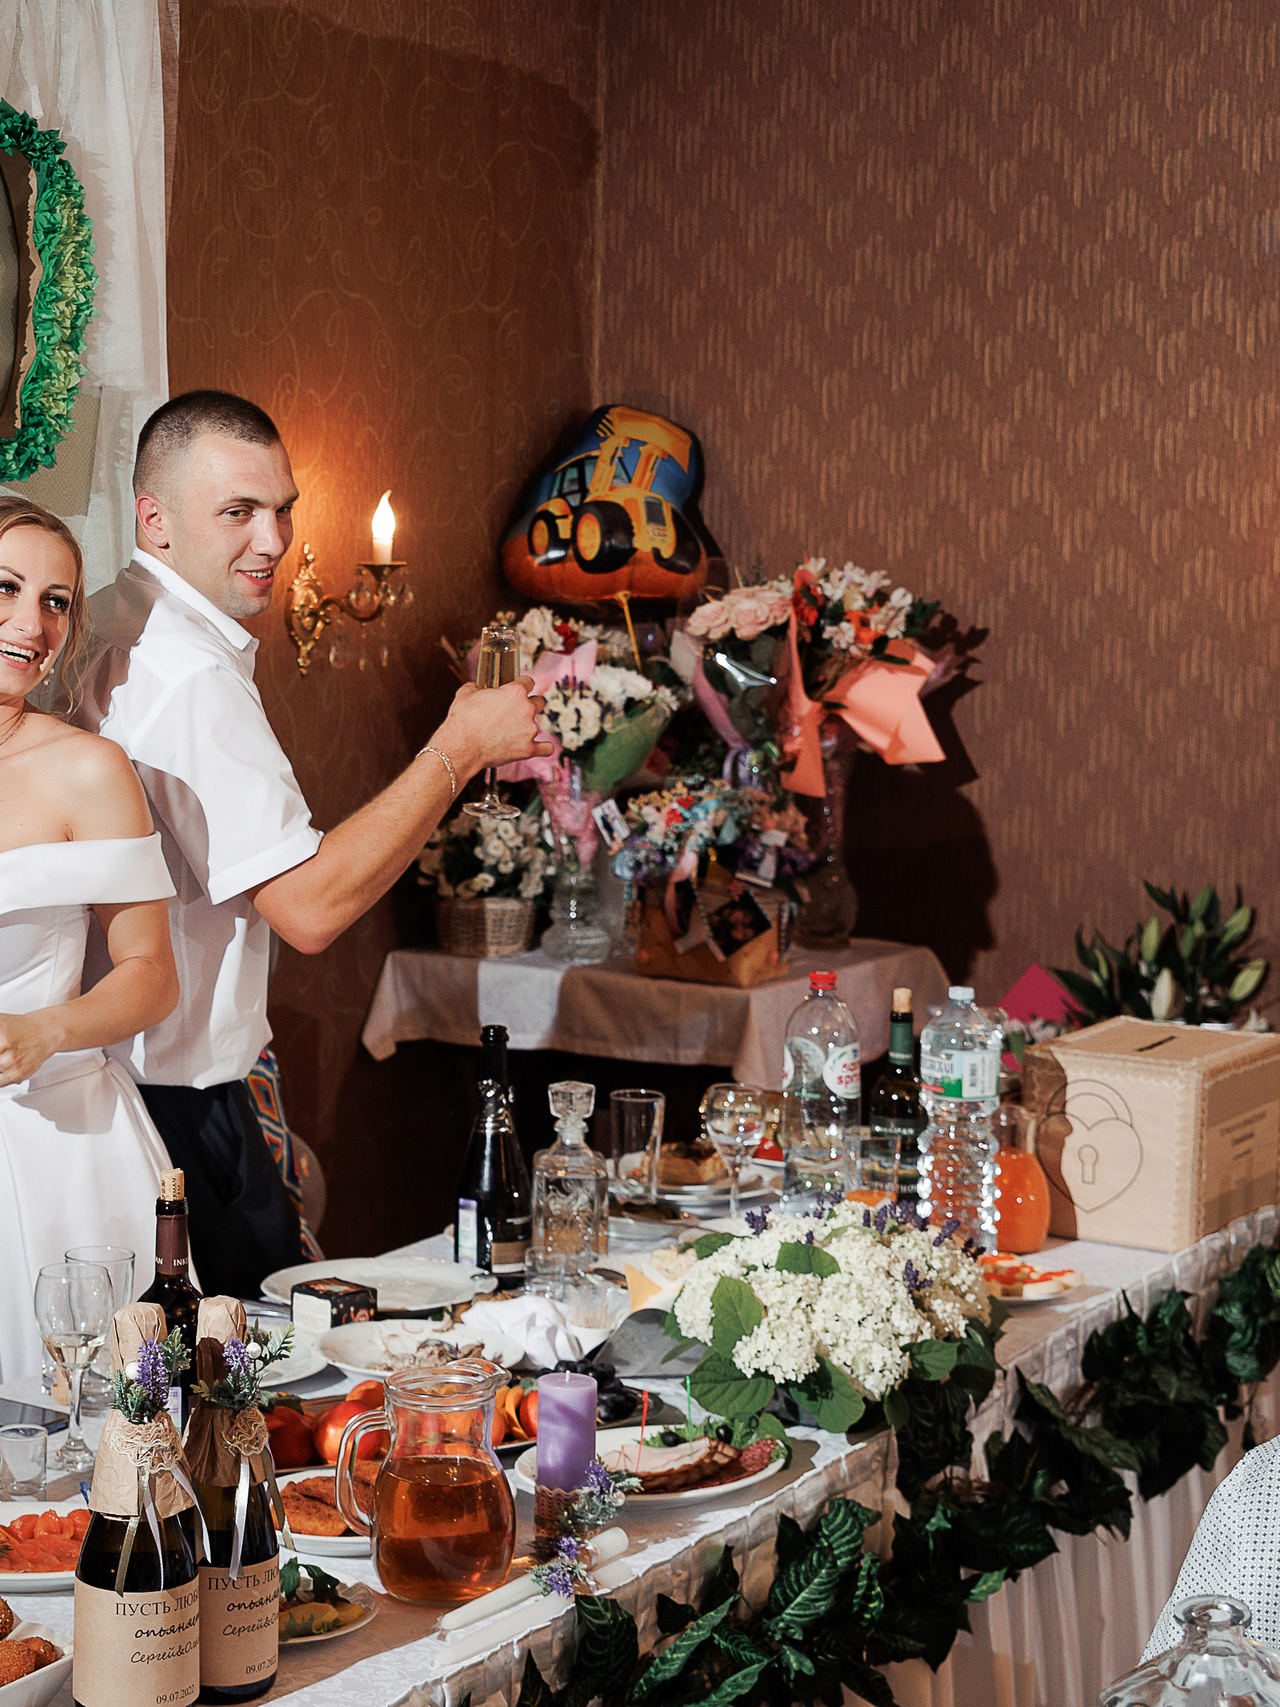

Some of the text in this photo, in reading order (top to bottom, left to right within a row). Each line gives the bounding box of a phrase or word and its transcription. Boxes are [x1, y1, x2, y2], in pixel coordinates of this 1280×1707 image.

[208, 1574, 260, 1591] ПУСТЬ
[115, 1601, 171, 1616] ПУСТЬ
[155, 1683, 195, 1705] 09.07.2022
